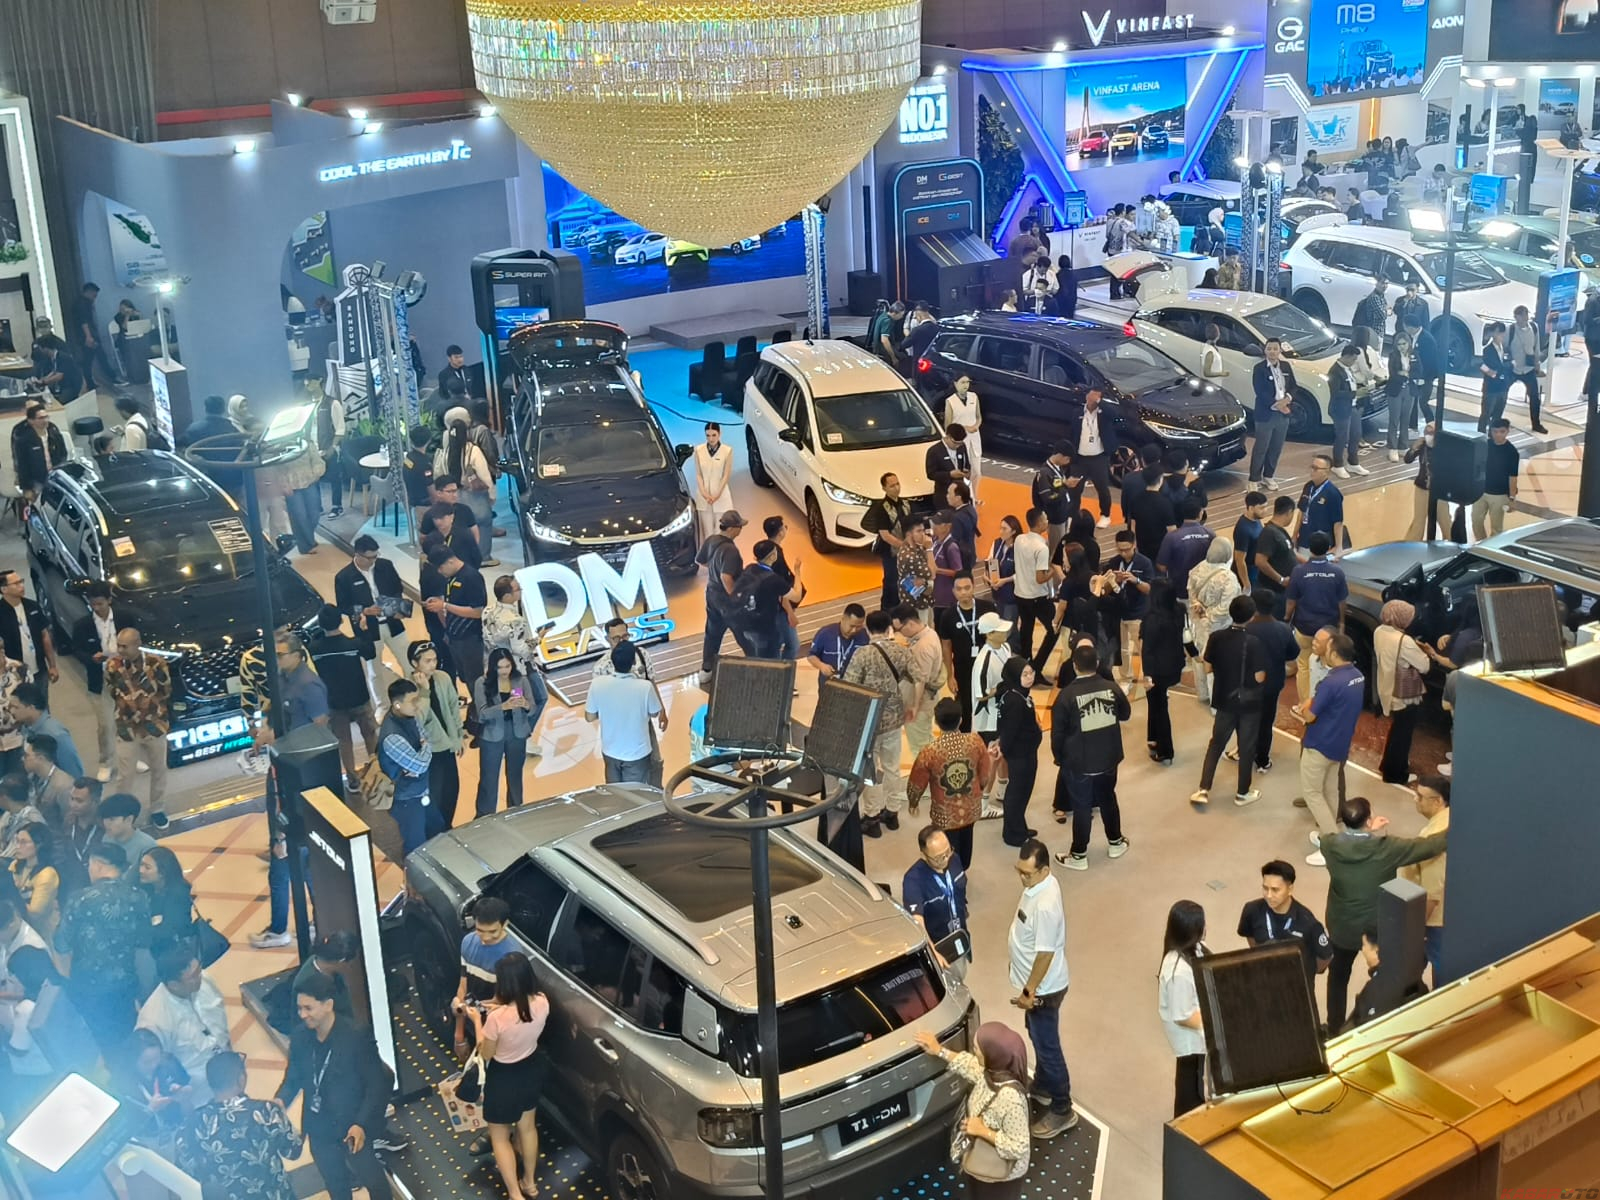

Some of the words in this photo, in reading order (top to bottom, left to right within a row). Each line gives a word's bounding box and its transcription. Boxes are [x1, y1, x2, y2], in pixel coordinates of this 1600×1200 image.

[1116, 14, 1194, 33] VINFAST
[1431, 15, 1464, 29] AION
[1275, 40, 1305, 53] GAC
[1093, 83, 1129, 95] VINFAST
[1131, 80, 1160, 92] ARENA
[319, 165, 358, 182] COOL
[358, 160, 386, 175] THE
[386, 153, 431, 170] EARTH
[431, 149, 450, 163] BY
[513, 540, 669, 638] DM
[166, 713, 251, 748] TIGG
[194, 743, 224, 758] BEST
[308, 830, 346, 871] JETOUR
[851, 1118, 869, 1132] T1
